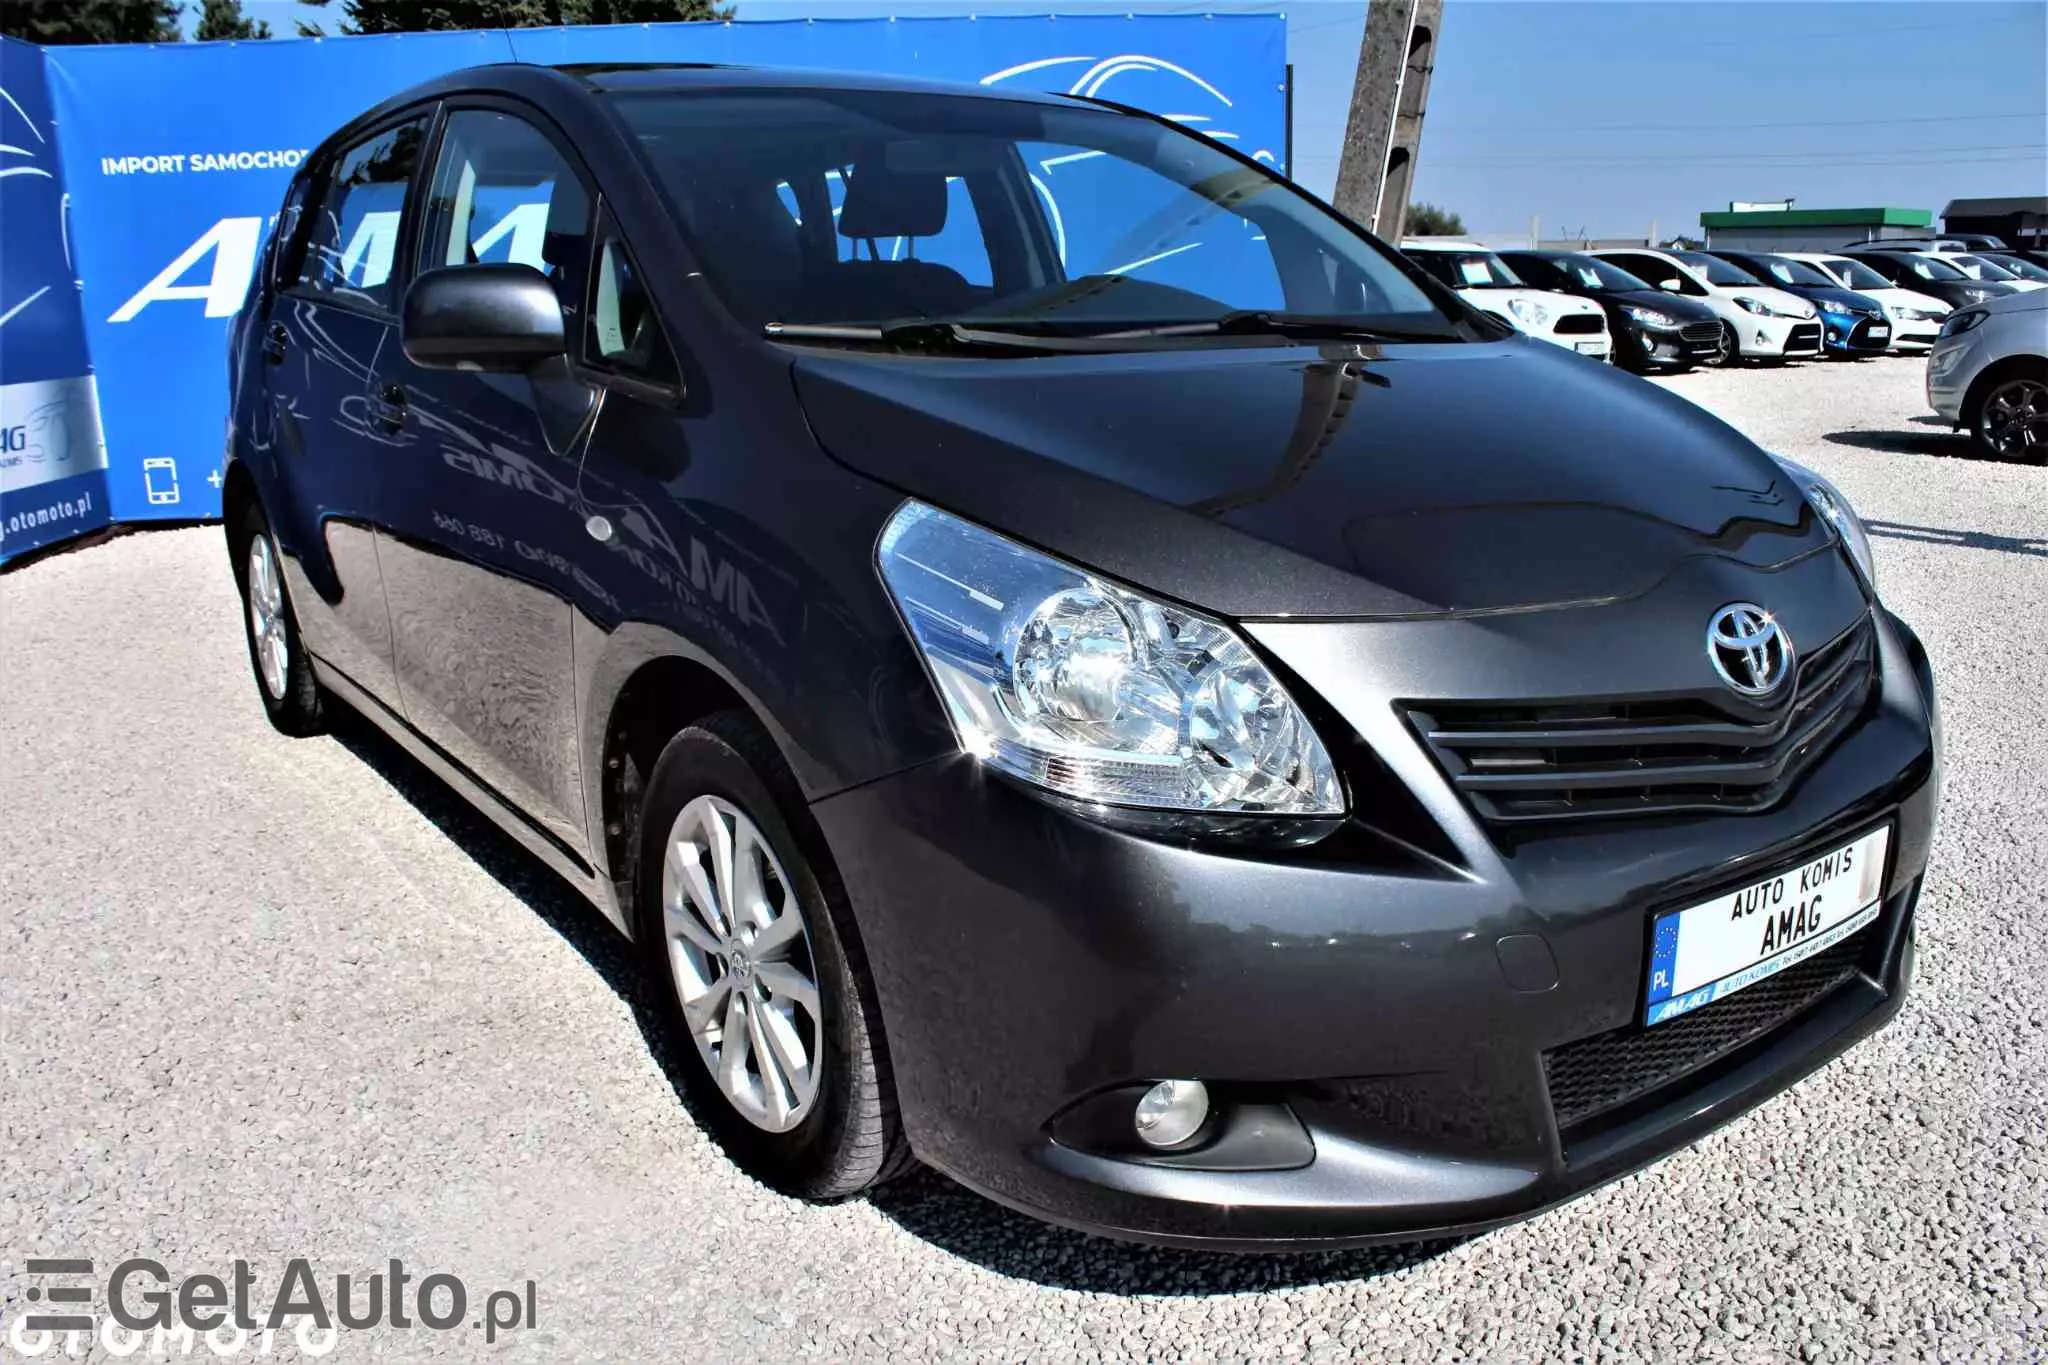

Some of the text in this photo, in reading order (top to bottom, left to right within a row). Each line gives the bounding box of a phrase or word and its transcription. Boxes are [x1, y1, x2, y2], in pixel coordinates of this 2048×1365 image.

[101, 149, 309, 175] IMPORT SAMOCHO
[1731, 847, 1853, 921] AUTO KOMIS
[1760, 894, 1822, 956] AMAG
[1653, 969, 1669, 991] PL
